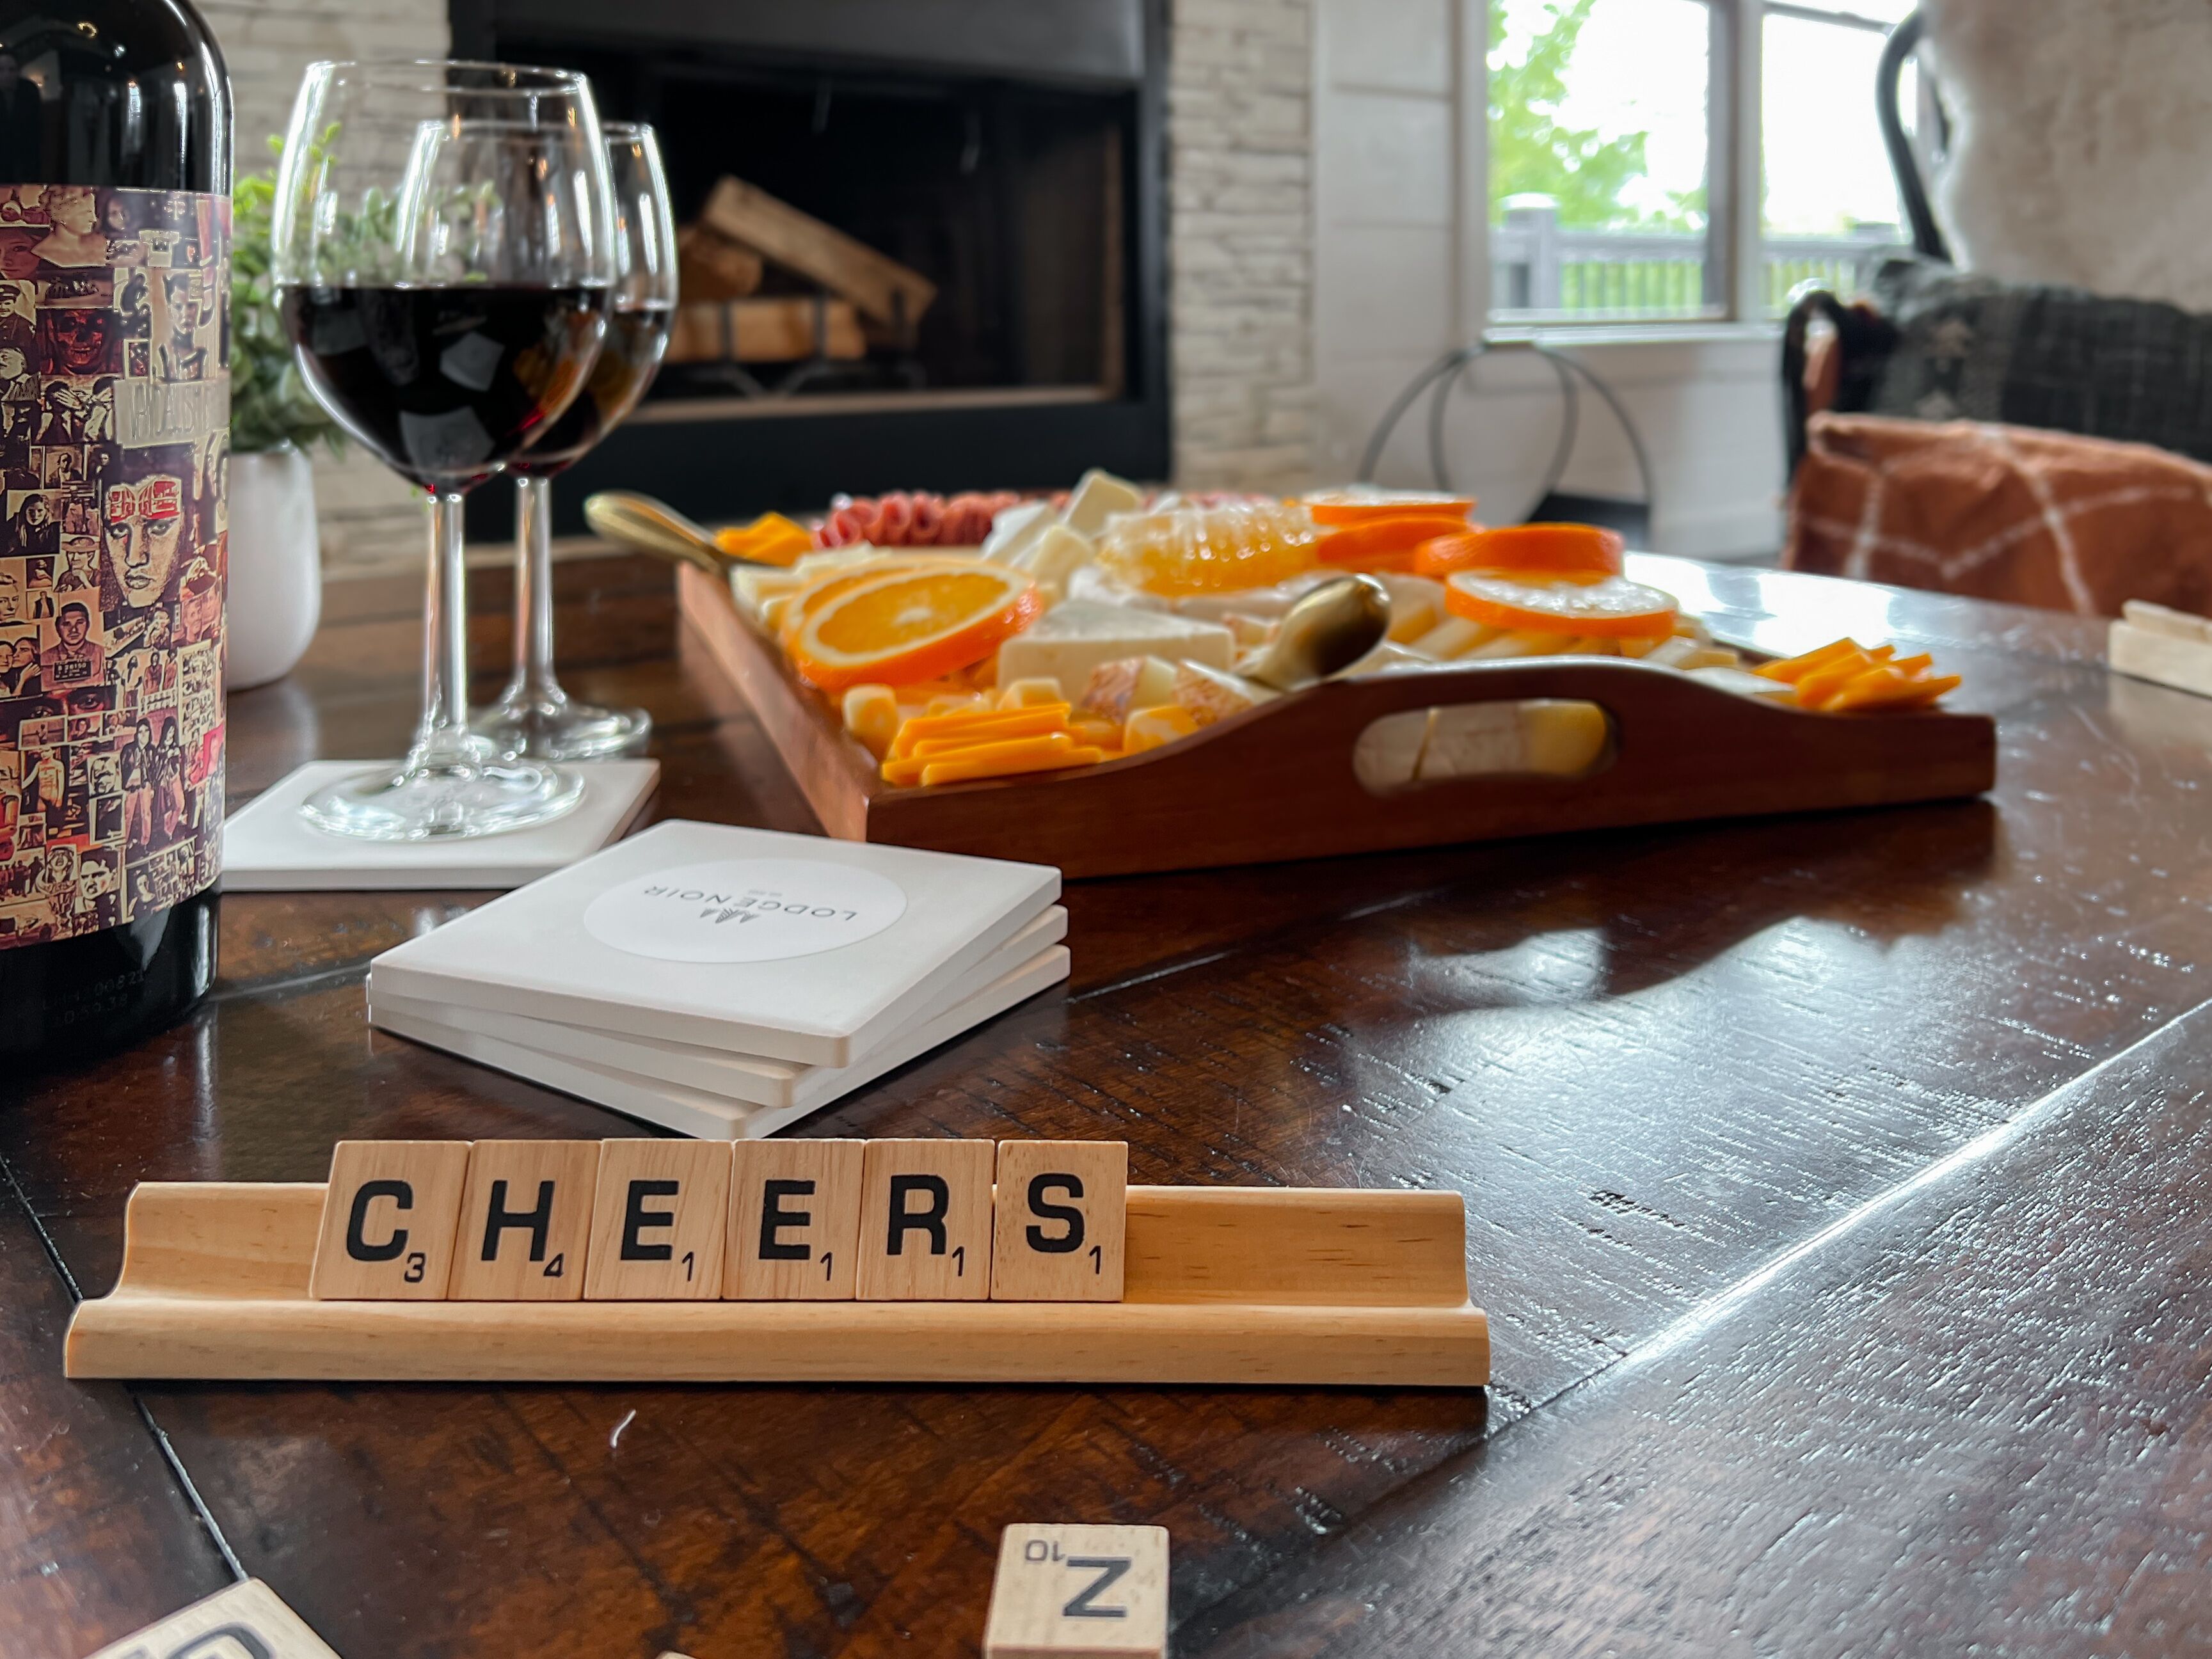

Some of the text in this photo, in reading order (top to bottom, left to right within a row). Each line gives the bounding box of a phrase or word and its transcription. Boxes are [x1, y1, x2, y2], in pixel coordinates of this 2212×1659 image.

[644, 886, 857, 921] LODGE NOIR
[346, 1173, 1085, 1262] CHEERS
[404, 1244, 1102, 1283] 3 4 1 1 1 1
[1025, 1539, 1065, 1562] 10
[1062, 1556, 1132, 1618] Z
